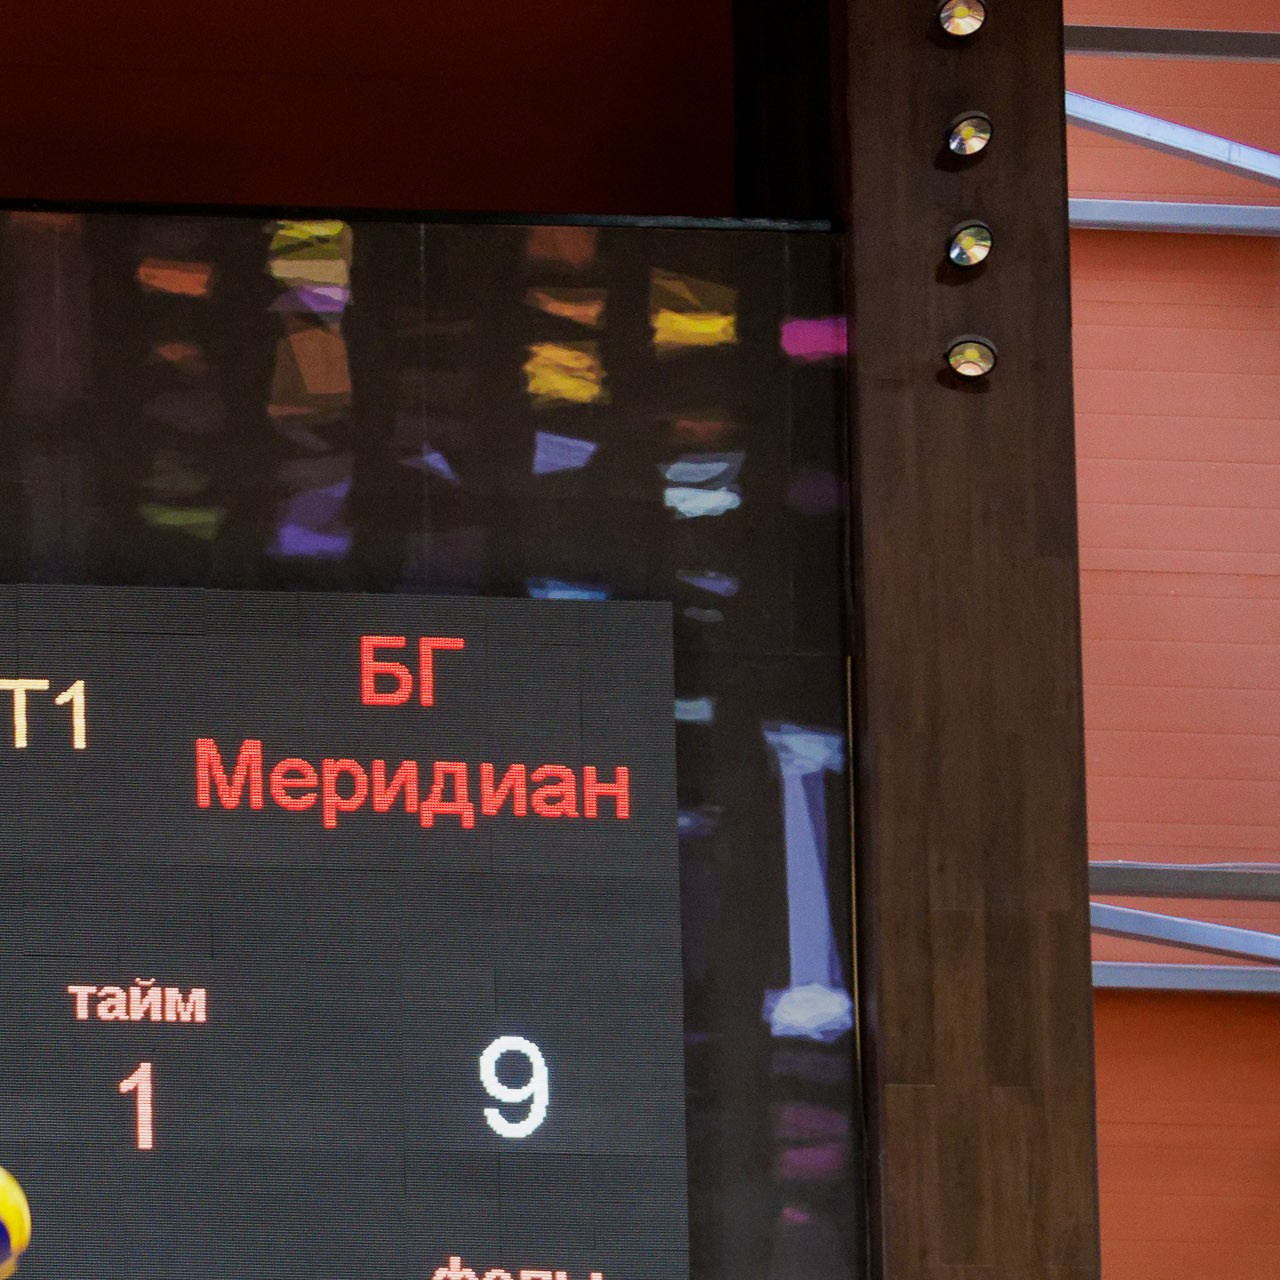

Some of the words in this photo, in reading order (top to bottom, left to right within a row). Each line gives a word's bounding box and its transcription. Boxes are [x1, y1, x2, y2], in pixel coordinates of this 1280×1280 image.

[359, 635, 466, 708] БГ
[194, 737, 631, 830] Меридиан
[66, 976, 208, 1024] тайм
[117, 1061, 155, 1151] 1
[478, 1035, 551, 1139] 9
